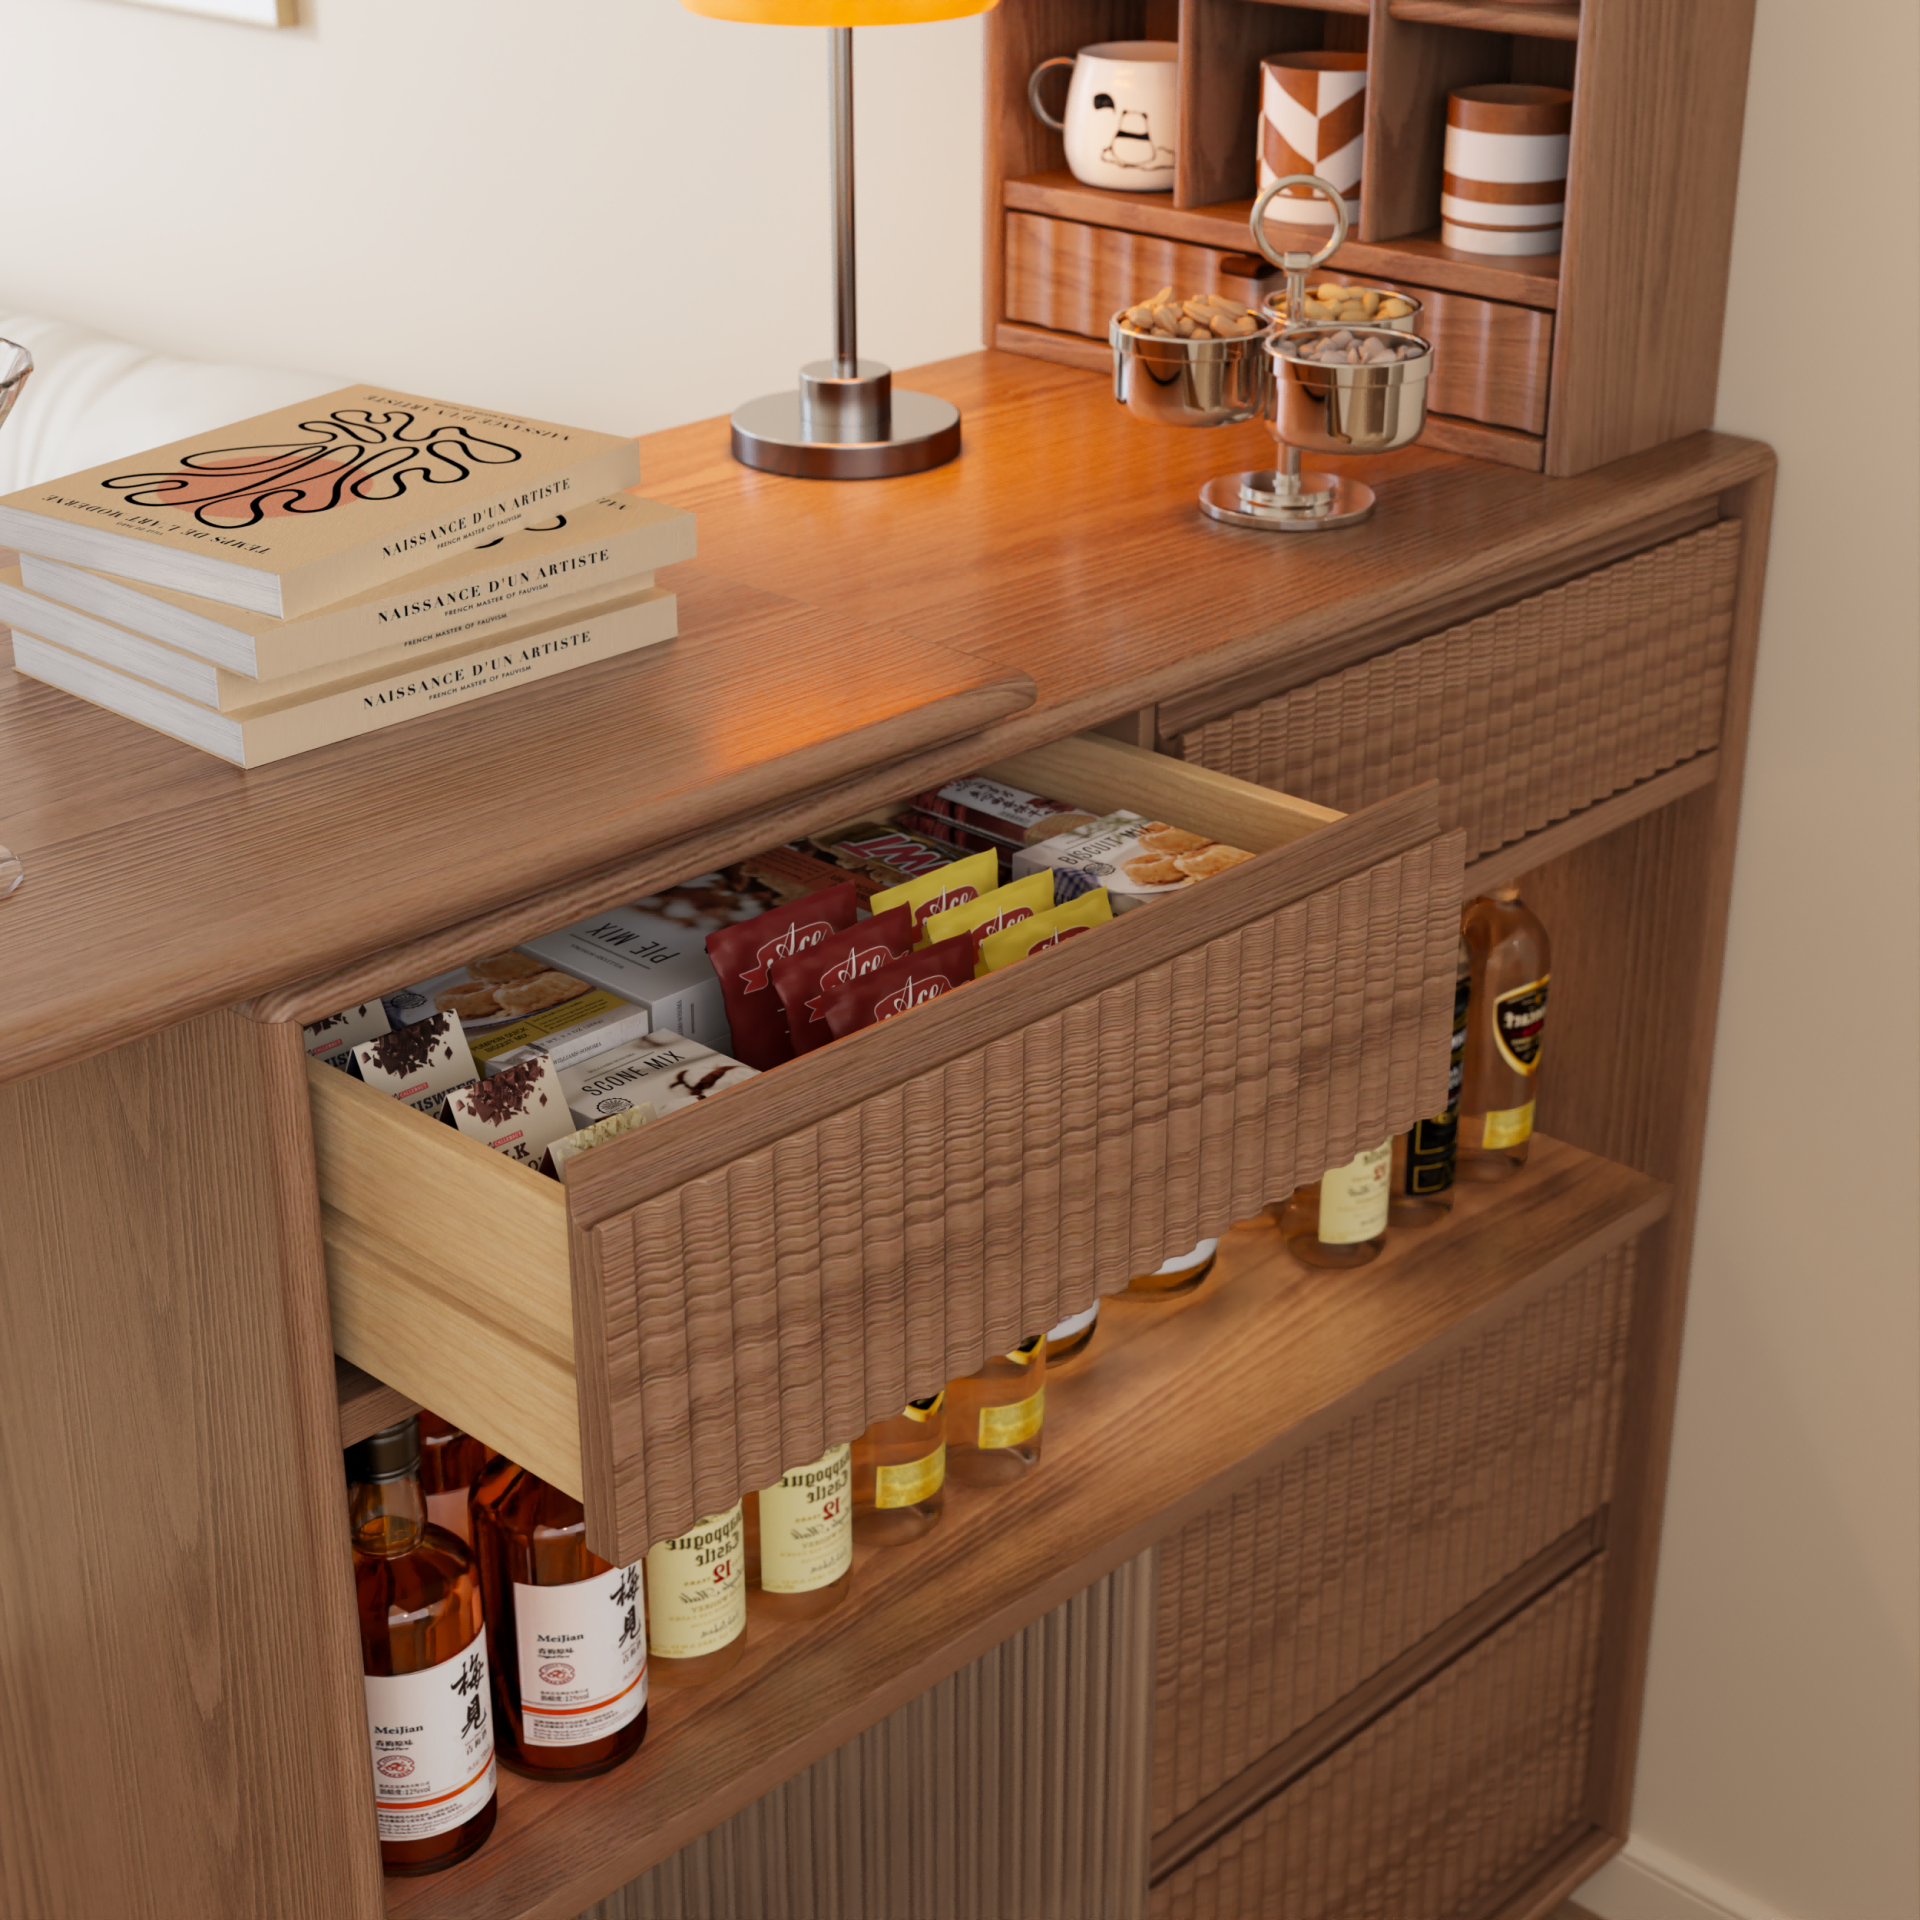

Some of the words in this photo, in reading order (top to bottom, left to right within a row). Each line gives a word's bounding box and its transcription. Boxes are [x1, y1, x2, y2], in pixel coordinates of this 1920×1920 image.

[42, 493, 123, 519] MODERNE
[382, 516, 468, 559] NAISSANCE
[472, 502, 507, 526] D'UN
[511, 477, 571, 510] ARTISTE
[180, 527, 210, 540] DE
[210, 533, 271, 555] TEMPS
[436, 535, 461, 550] FRENCH
[462, 528, 485, 542] MASTER
[487, 523, 495, 532] OF
[497, 513, 522, 528] FAUVISM
[378, 585, 481, 625] NAISSANCE
[489, 572, 530, 592] D'UN
[537, 549, 610, 580] ARTISTE
[444, 604, 474, 617] FRENCH
[476, 596, 504, 610] MASTER
[506, 591, 516, 600] OF
[518, 582, 549, 596] FAUVISM
[404, 634, 433, 647] FRENCH
[435, 625, 463, 639] MASTER
[464, 621, 475, 630] OF
[477, 612, 508, 626] FAUVISM
[363, 668, 465, 710] NAISSANCE
[472, 655, 513, 677] D'UN
[519, 631, 592, 663] ARTISTE
[428, 688, 458, 701] FRENCH
[460, 679, 487, 692] MASTER
[489, 675, 500, 684] OF
[502, 664, 532, 679] FAUVISM
[1057, 835, 1123, 865] BISCUIT
[1119, 823, 1156, 840] MIX
[929, 885, 974, 915] Ace
[585, 922, 640, 946] MIX
[773, 922, 828, 962] Ace
[629, 940, 681, 964] PIE
[837, 947, 887, 983] Ace
[893, 975, 945, 1012] Ace
[313, 1039, 342, 1054] CALLEBAUT
[470, 1035, 506, 1051] PUMPKIN
[553, 1041, 602, 1065] WILLIAMS-SONOMA
[582, 1066, 649, 1097] SCONE
[643, 1050, 686, 1071] MIX
[400, 1082, 428, 1098] CALLEBAUT
[494, 1131, 523, 1147] CALLEBAUT
[537, 1634, 584, 1643] MeiJian
[373, 1725, 424, 1736] MeiJian
